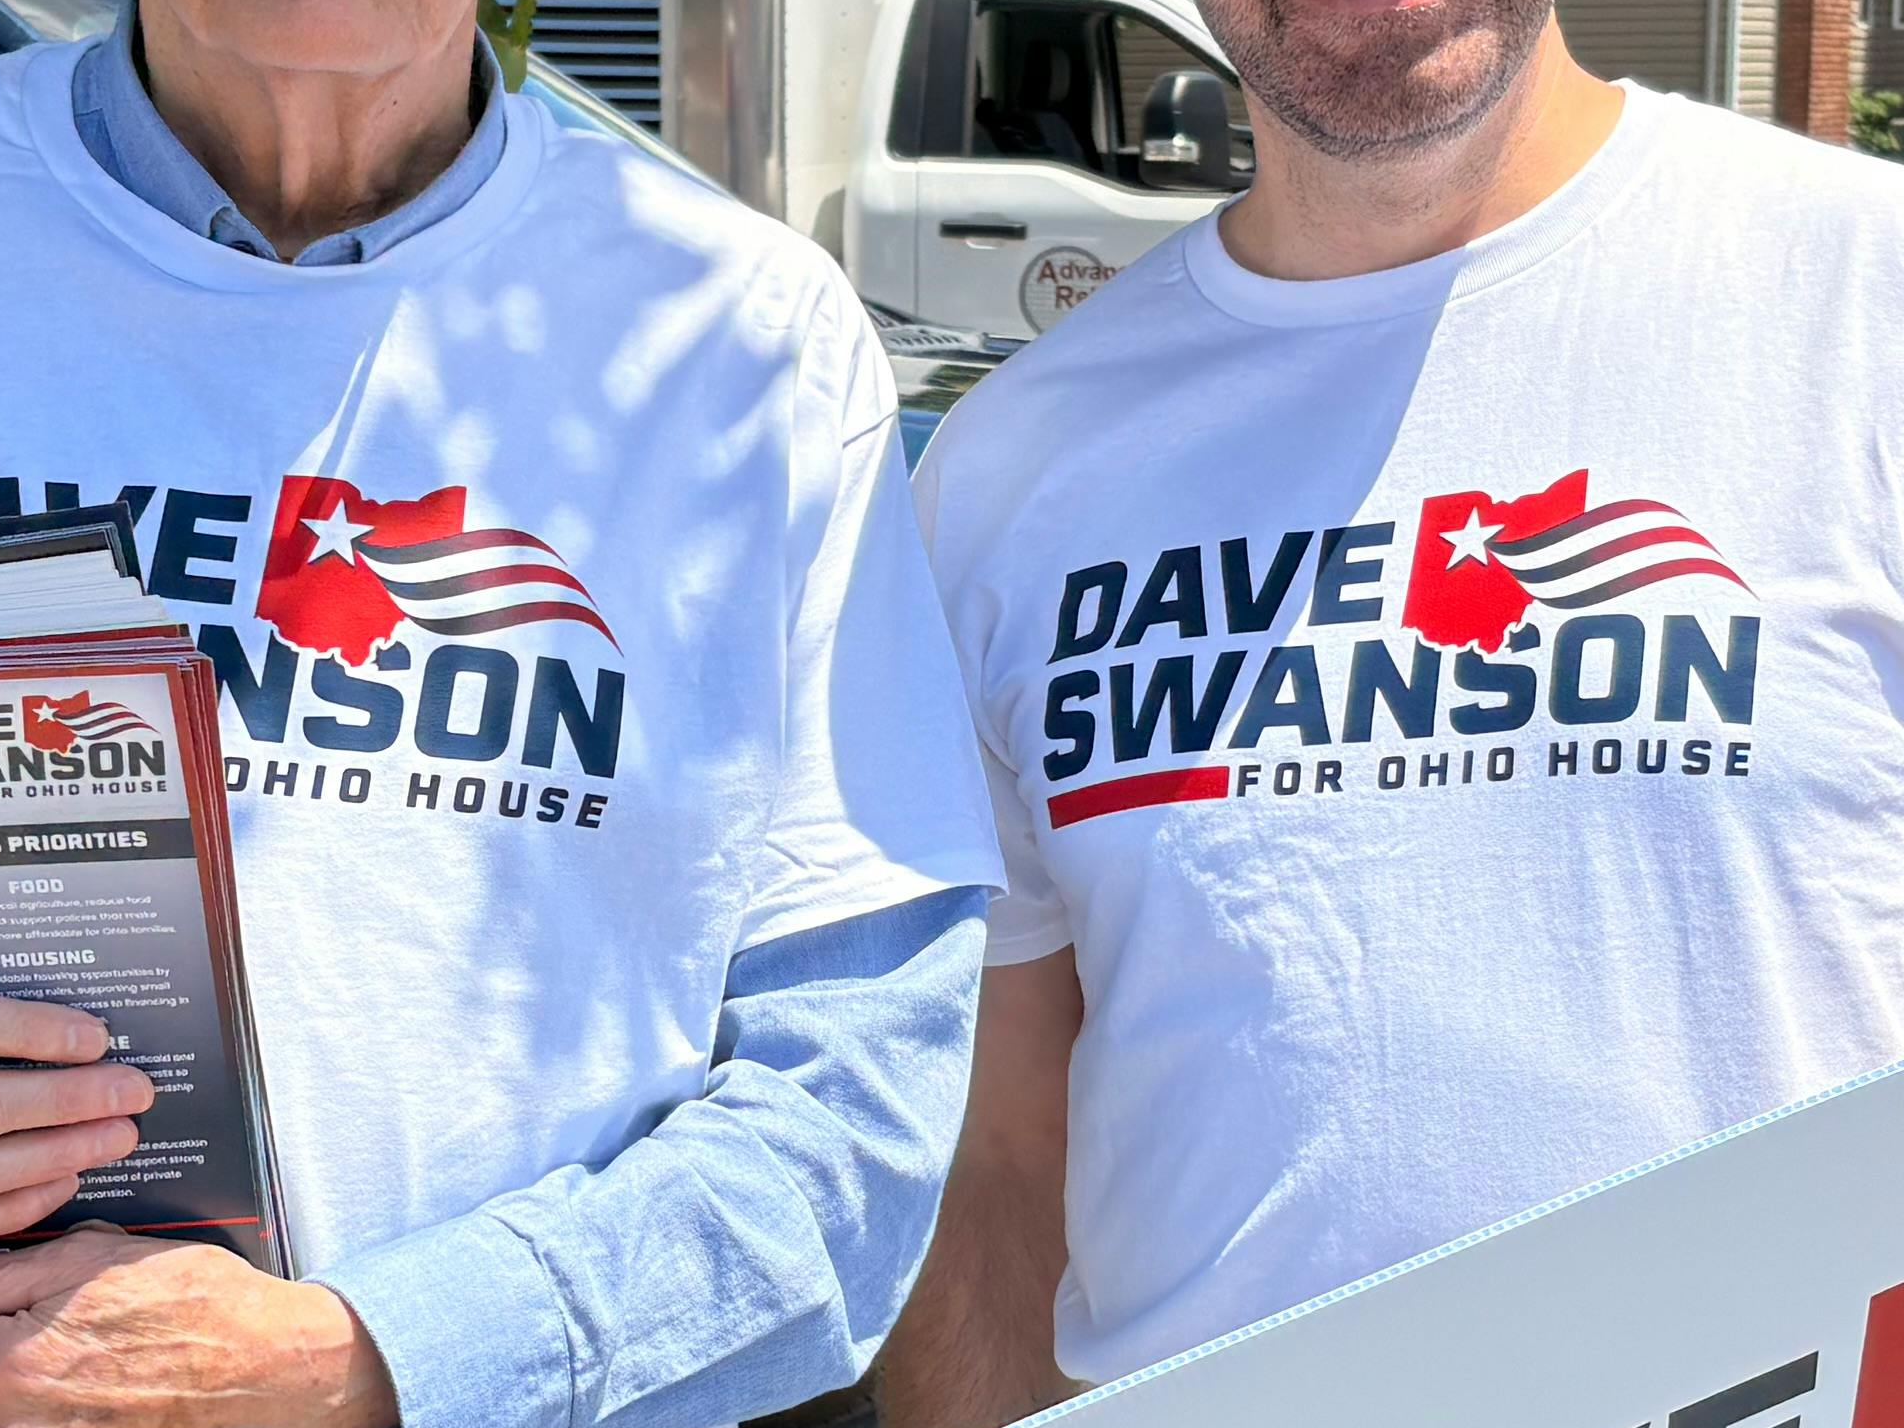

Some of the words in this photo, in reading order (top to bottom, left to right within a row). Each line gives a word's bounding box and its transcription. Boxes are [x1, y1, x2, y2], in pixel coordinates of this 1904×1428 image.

[1037, 259, 1127, 284] Advan
[1047, 520, 1396, 666] DAVE
[1043, 614, 1762, 782] SWANSON
[1235, 760, 1345, 799] FOR
[1376, 745, 1515, 792] OHIO
[1547, 738, 1752, 778] HOUSE
[26, 783, 81, 798] OHIO
[92, 780, 168, 795] HOUSE
[405, 771, 610, 829] HOUSE
[8, 830, 148, 853] PRIORITIES
[8, 878, 65, 894] FOOD
[0, 949, 97, 968] HOUSING
[33, 969, 79, 983] housing
[155, 966, 171, 979] by
